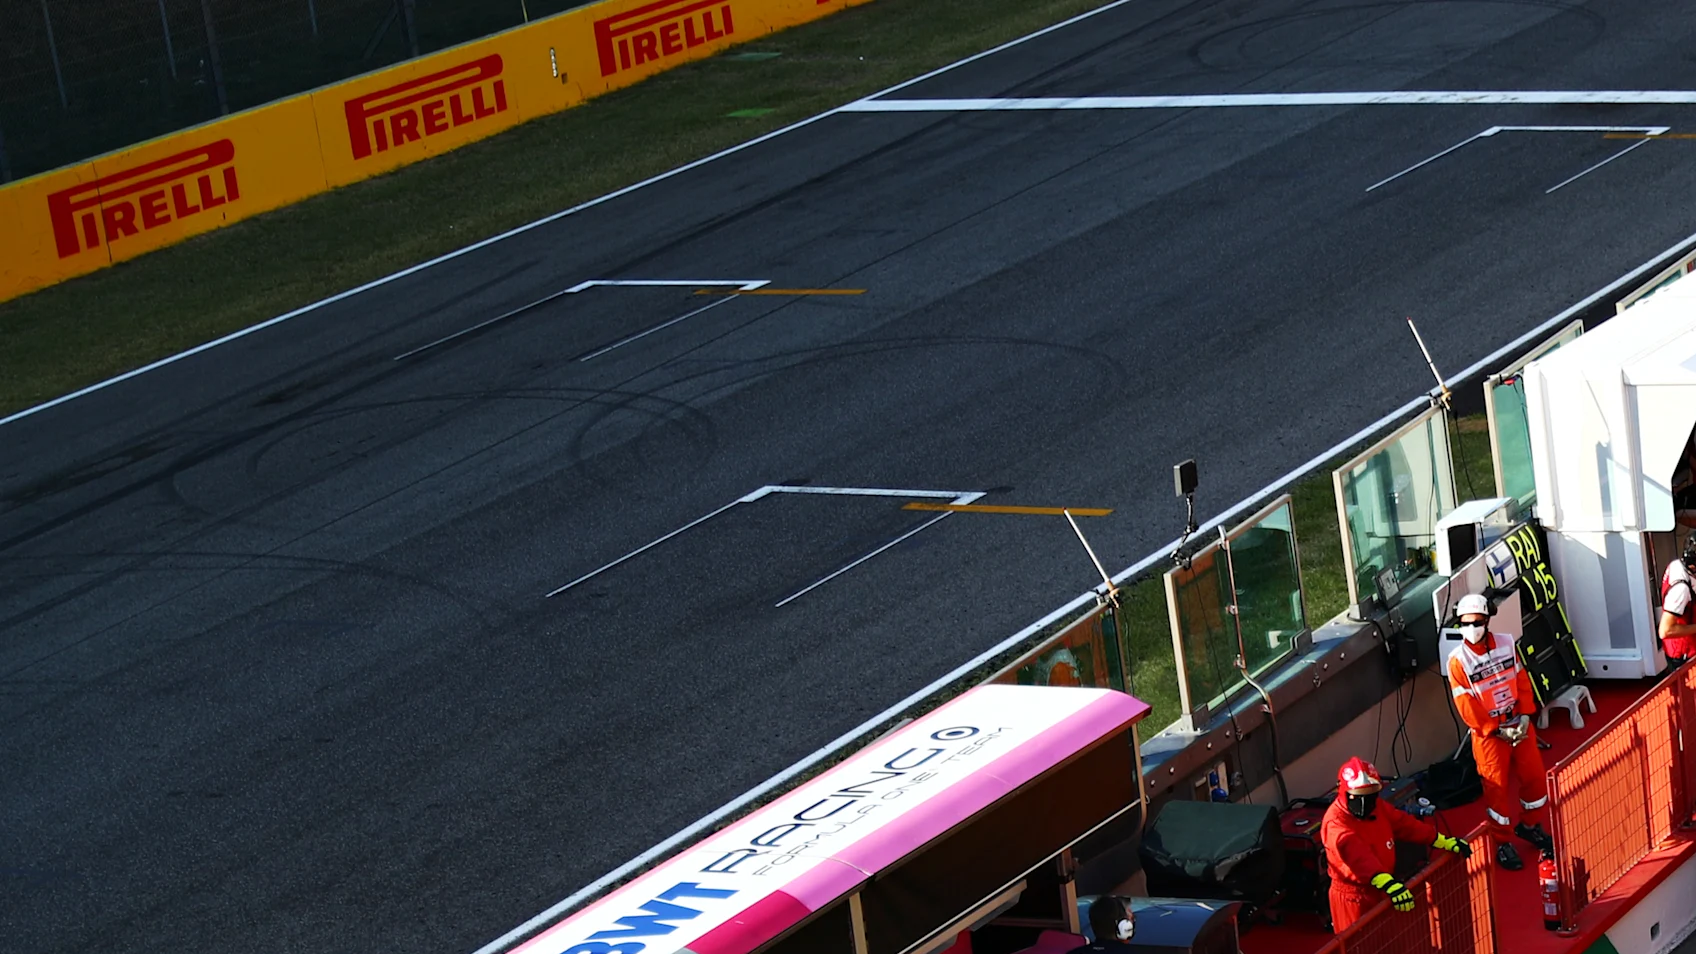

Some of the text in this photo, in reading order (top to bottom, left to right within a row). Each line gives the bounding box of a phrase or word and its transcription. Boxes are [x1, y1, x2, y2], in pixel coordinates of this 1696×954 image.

[594, 0, 735, 77] PIRELLI
[344, 53, 508, 161] PIRELLI
[47, 138, 240, 260] PIRELLI
[700, 747, 946, 876] RACING
[752, 804, 883, 877] FORMULA
[941, 726, 1014, 765] TEAM
